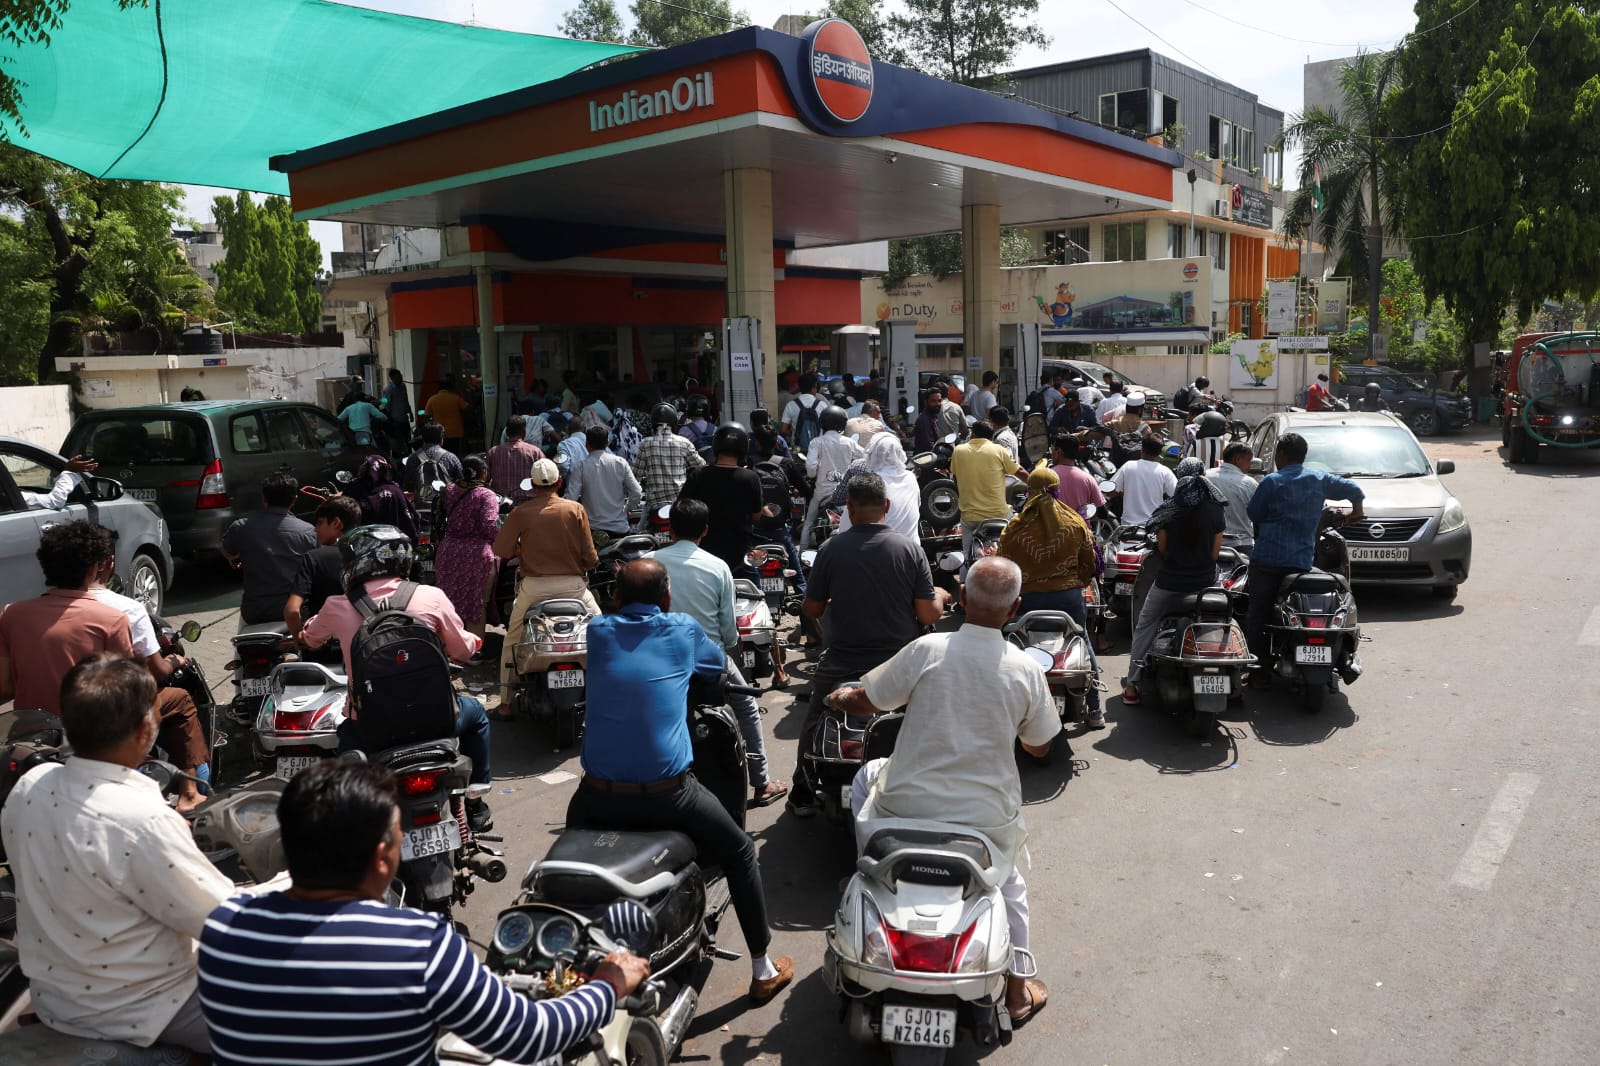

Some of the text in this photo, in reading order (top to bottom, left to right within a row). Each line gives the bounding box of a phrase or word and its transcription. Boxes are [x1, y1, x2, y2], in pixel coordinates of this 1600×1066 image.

[589, 71, 715, 132] IndianOil
[1201, 685, 1225, 693] A6405
[410, 824, 448, 844] GJ01X
[412, 839, 451, 857] G6598
[911, 865, 951, 876] HONDA
[905, 1008, 940, 1026] GJ01
[894, 1025, 951, 1045] NZ6446
